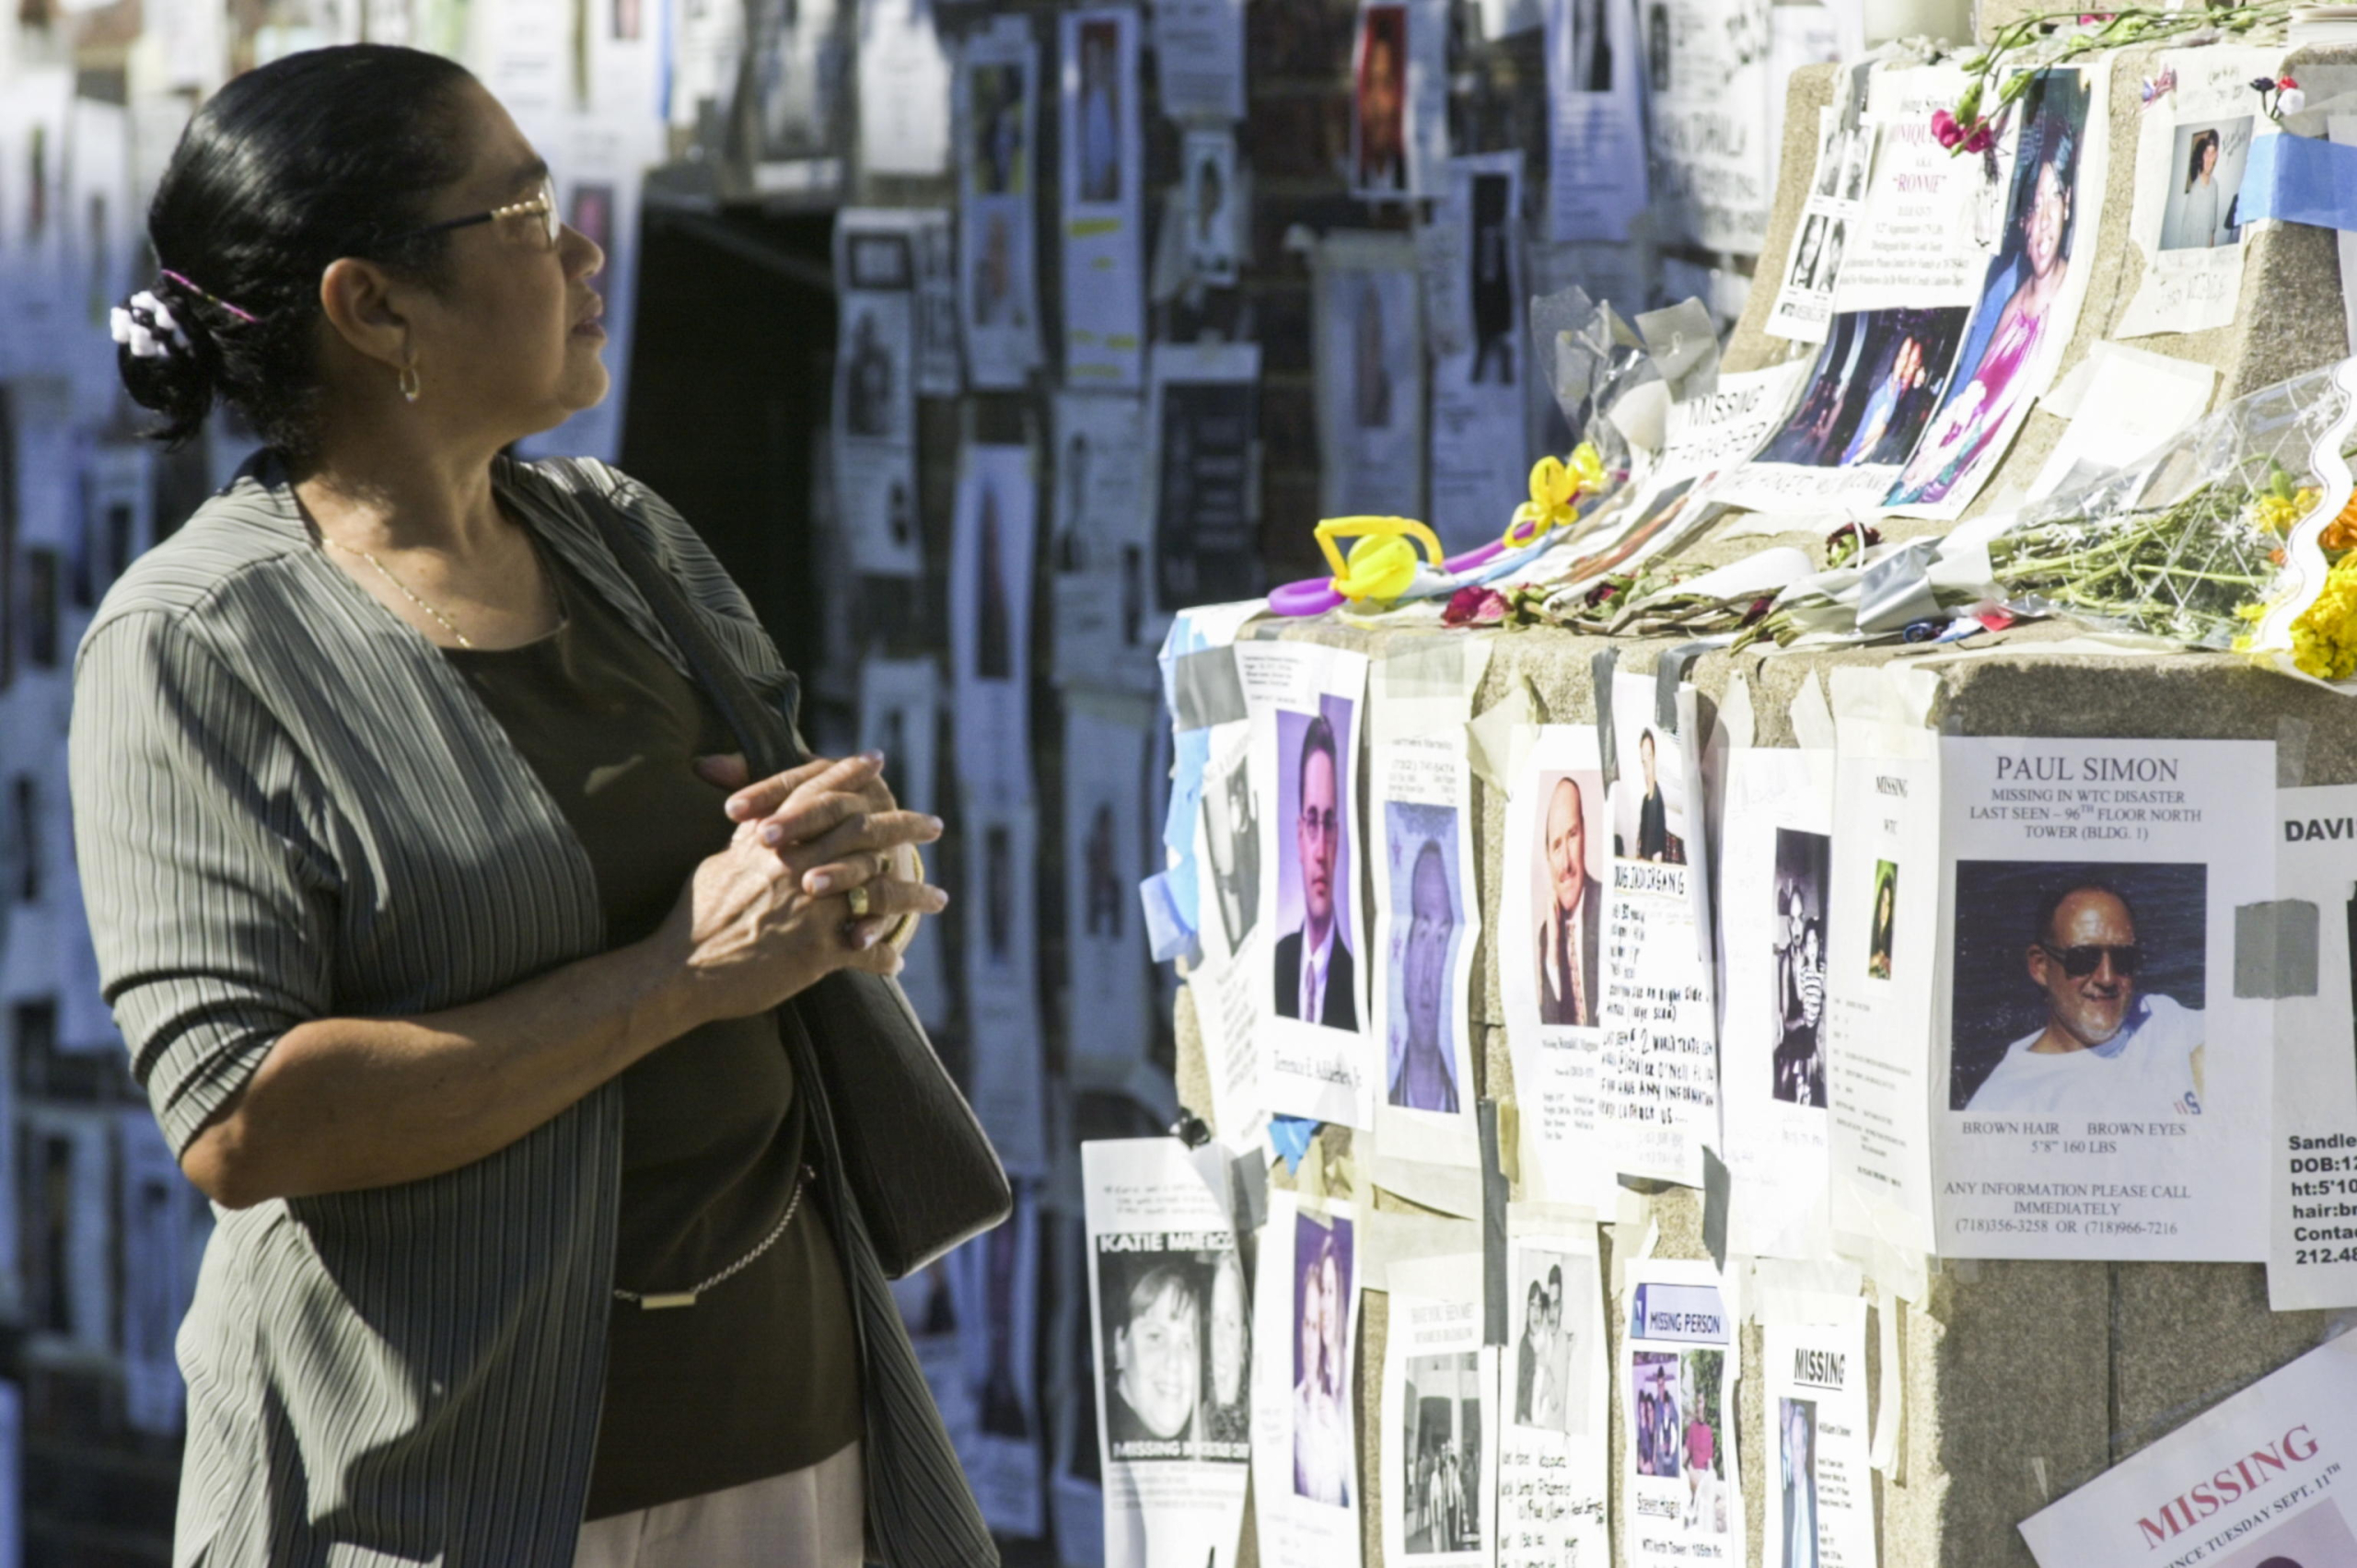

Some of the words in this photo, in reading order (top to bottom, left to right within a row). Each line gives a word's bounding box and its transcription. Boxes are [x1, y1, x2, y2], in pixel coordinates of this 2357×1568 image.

[1996, 756, 2073, 781] PAUL
[2083, 758, 2178, 782] SIMON
[1875, 775, 1909, 798] MISSING
[1991, 788, 2053, 802] MISSING
[2058, 789, 2072, 802] IN
[2077, 789, 2110, 803] WTC
[2114, 790, 2185, 804] DISASTER
[1969, 806, 2008, 819] LAST
[2012, 807, 2049, 819] SEEN
[2097, 807, 2146, 821] FLOOR
[2150, 808, 2201, 822] NORTH
[2025, 825, 2078, 839] TOWER
[2082, 826, 2131, 842] (BLDG.
[2284, 818, 2357, 842] DAVI
[1962, 1121, 2018, 1134] BROWN
[2022, 1121, 2060, 1134] HAIR
[2087, 1122, 2144, 1135] BROWN
[2149, 1123, 2186, 1135] EYES
[2063, 1142, 2085, 1153] 160
[2089, 1142, 2117, 1154] LBS
[1945, 1182, 1977, 1195] ANY
[1981, 1182, 2087, 1197] INFORMATION
[2092, 1184, 2148, 1198] PLEASE
[2152, 1185, 2191, 1199] CALL
[2014, 1201, 2121, 1215] IMMEDIATELY
[1956, 1219, 2049, 1234] (718)356-3258
[2056, 1220, 2077, 1234] OR
[2084, 1220, 2178, 1236] (718)966-7216
[1101, 1233, 1163, 1252] KATIE
[1650, 1311, 1682, 1332] MISSING
[1684, 1312, 1721, 1334] PERSON
[1794, 1347, 1846, 1386] MISSING
[1112, 1439, 1180, 1458] MISSING
[2135, 1424, 2319, 1551] MISSING
[2163, 1547, 2206, 1568] INCE
[2204, 1506, 2272, 1552] TUESDAY
[2272, 1485, 2315, 1513] SEPT.
